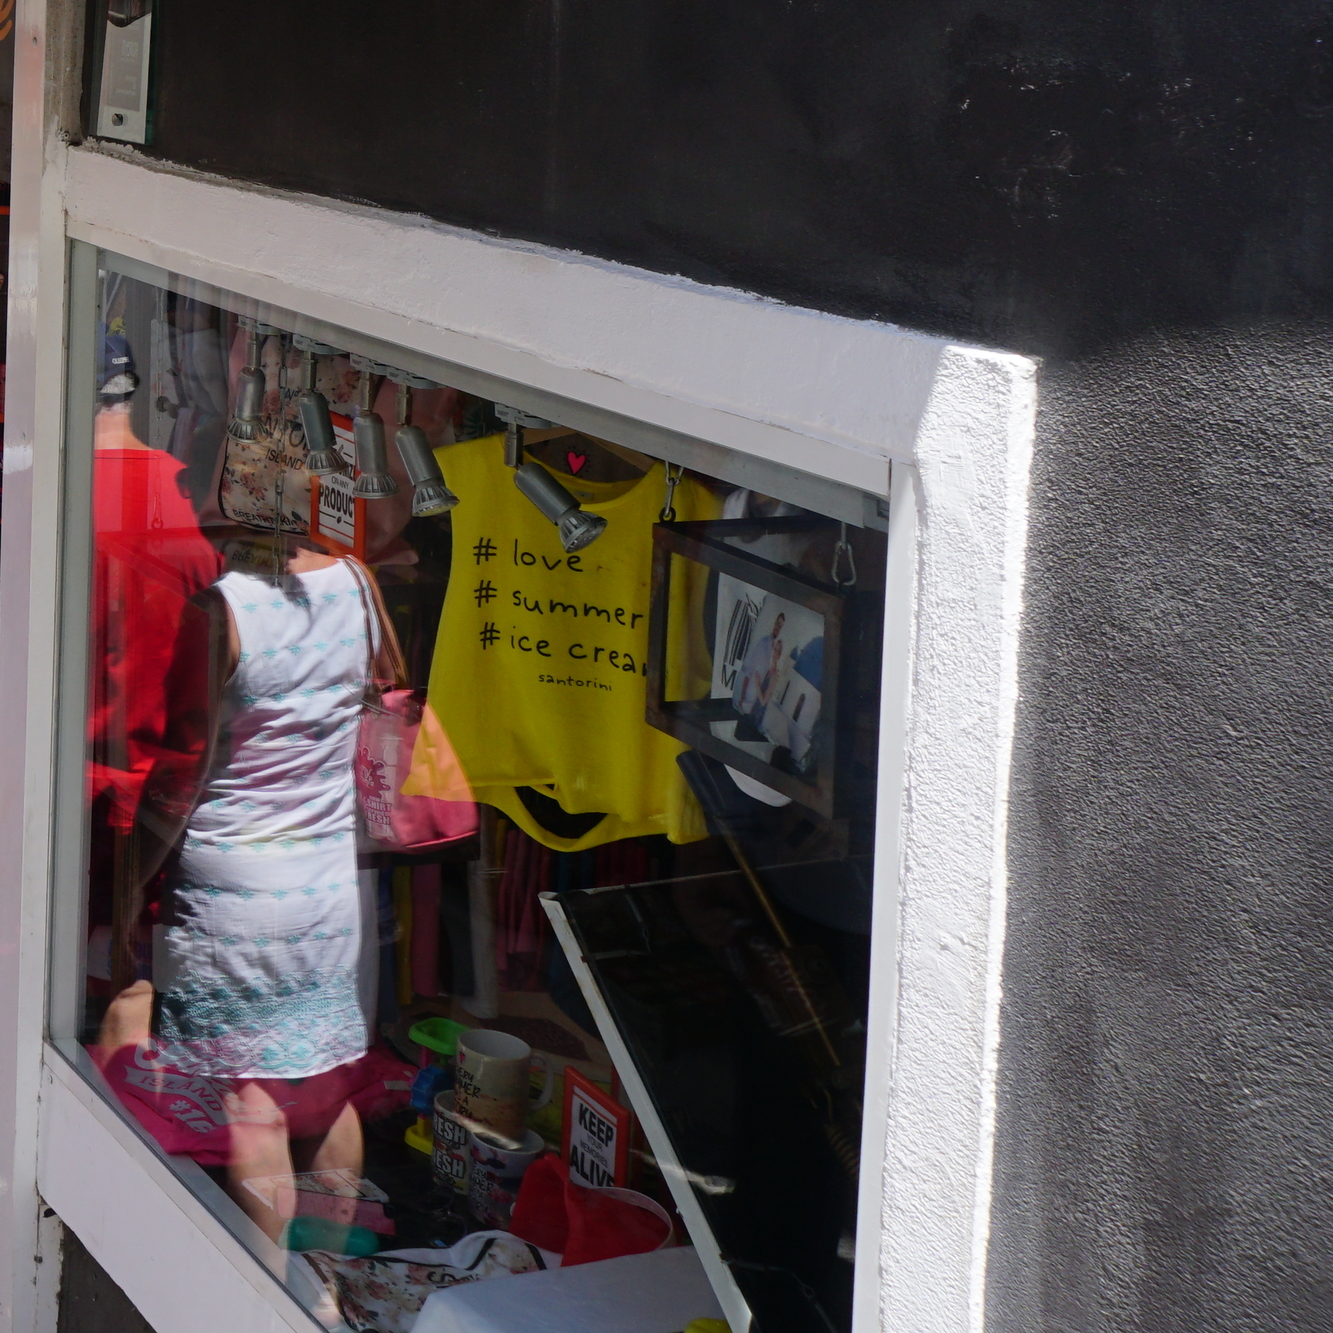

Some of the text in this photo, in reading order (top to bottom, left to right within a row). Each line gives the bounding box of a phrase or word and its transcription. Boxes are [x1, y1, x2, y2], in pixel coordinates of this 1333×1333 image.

[319, 483, 355, 517] PRODUC
[513, 539, 584, 573] love
[512, 590, 644, 630] summer
[510, 626, 552, 658] ice
[568, 642, 647, 678] crea
[537, 674, 613, 692] santorini
[139, 1076, 223, 1112] ISLAND
[579, 1103, 614, 1148] KEEP
[580, 1139, 609, 1169] MEMORIES
